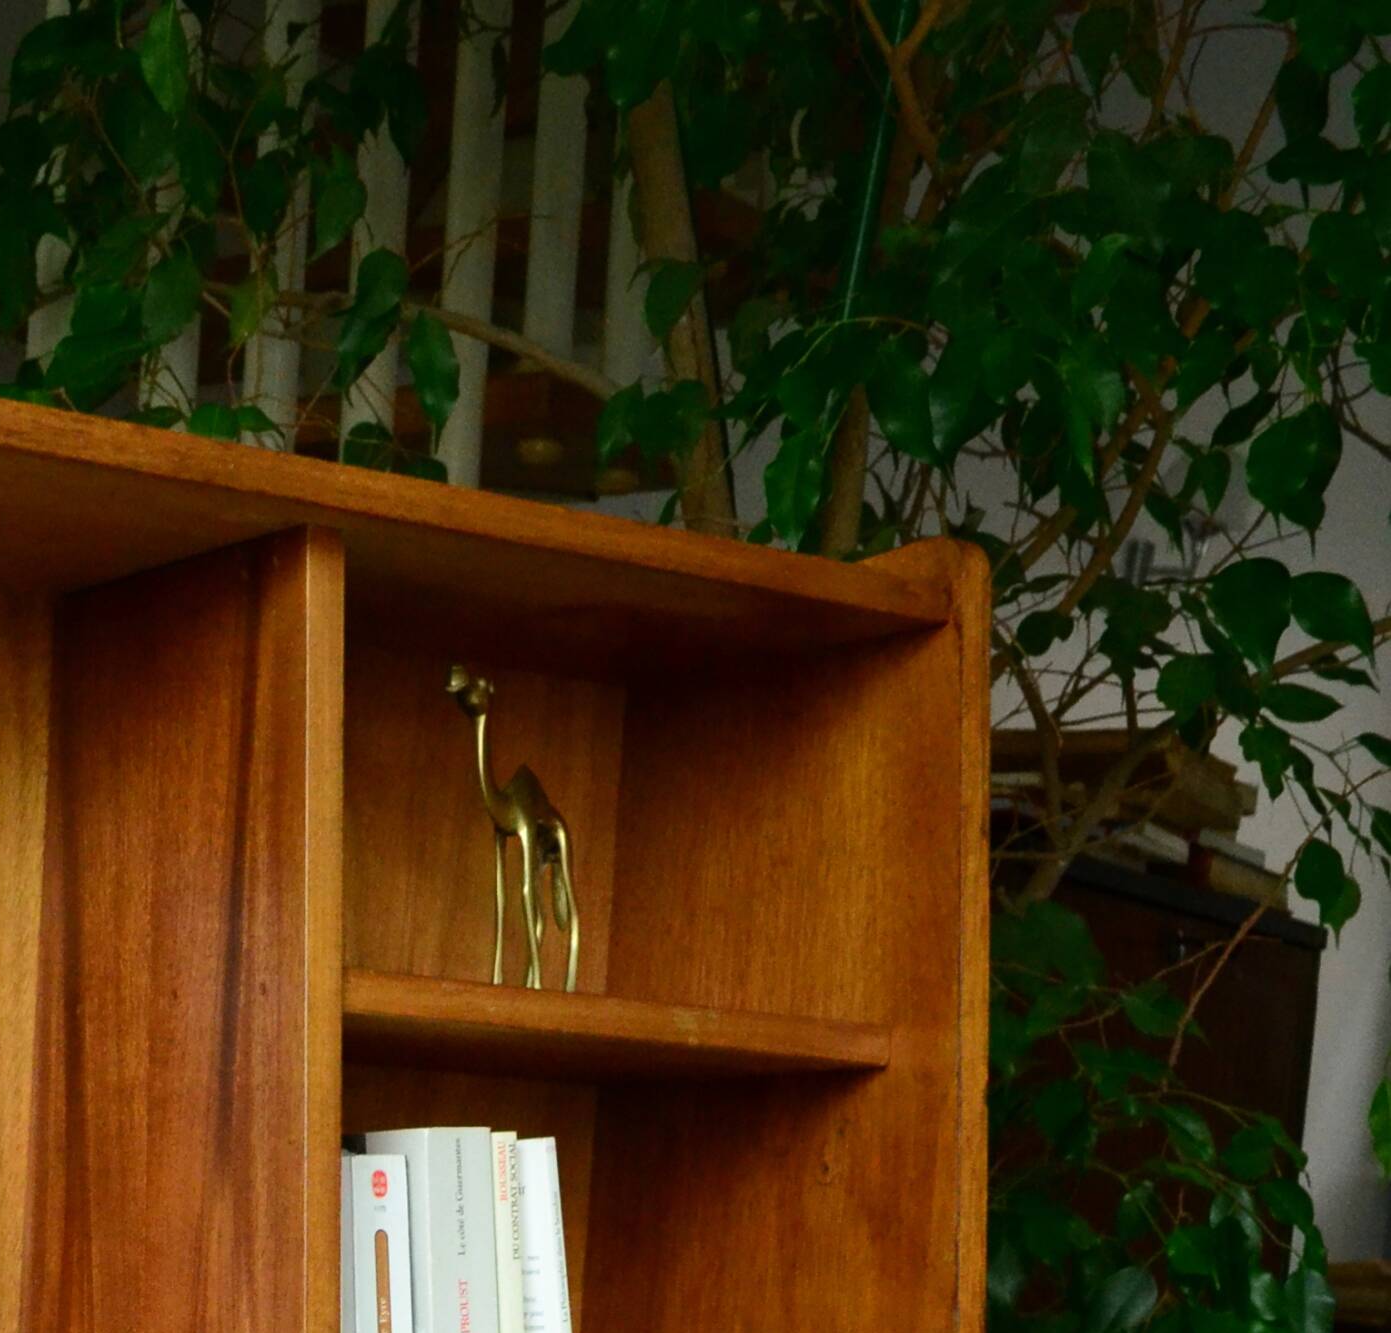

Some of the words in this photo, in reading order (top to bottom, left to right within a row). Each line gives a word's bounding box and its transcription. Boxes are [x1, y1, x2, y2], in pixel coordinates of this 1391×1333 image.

[497, 1141, 508, 1202] ROUSSEAU
[508, 1143, 518, 1181] SOCIAL
[510, 1186, 520, 1242] CONTRAT
[512, 1245, 520, 1260] DU
[379, 1296, 391, 1324] Eyre
[458, 1279, 470, 1333] PROUST
